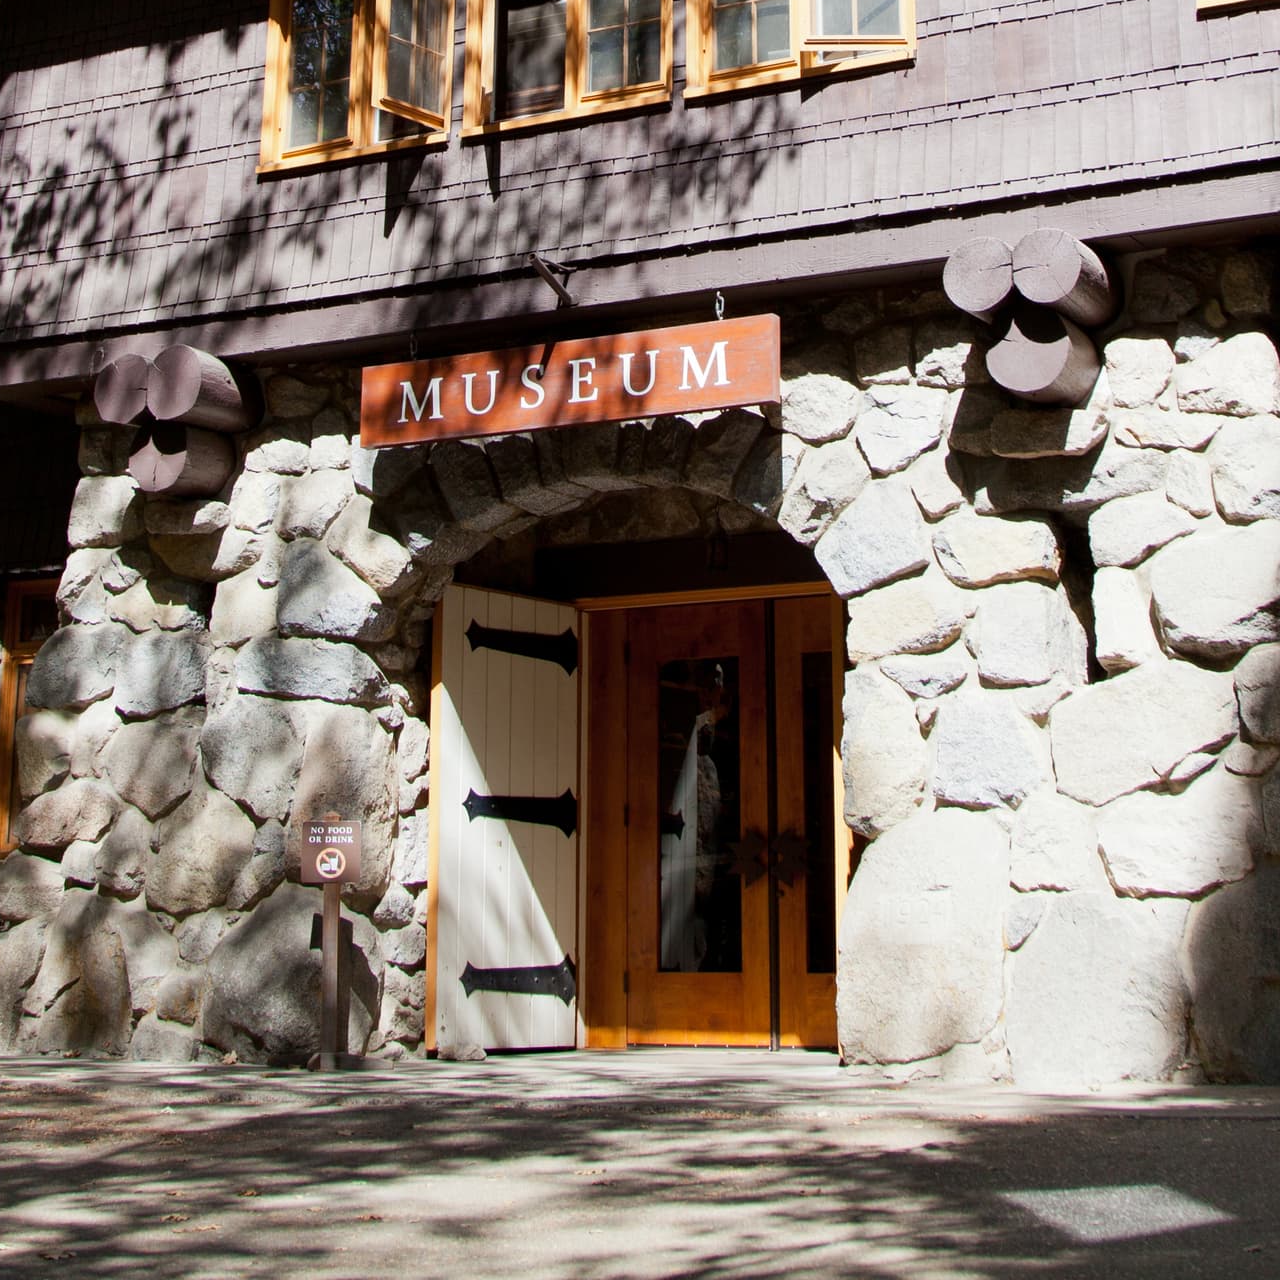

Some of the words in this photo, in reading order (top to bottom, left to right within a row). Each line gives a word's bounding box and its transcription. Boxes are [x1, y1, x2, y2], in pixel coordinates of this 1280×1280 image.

[397, 340, 732, 423] MUSEUM
[310, 826, 324, 834] NO
[328, 826, 353, 834] FOOD
[308, 835, 322, 844] OR
[325, 835, 354, 844] DRINK
